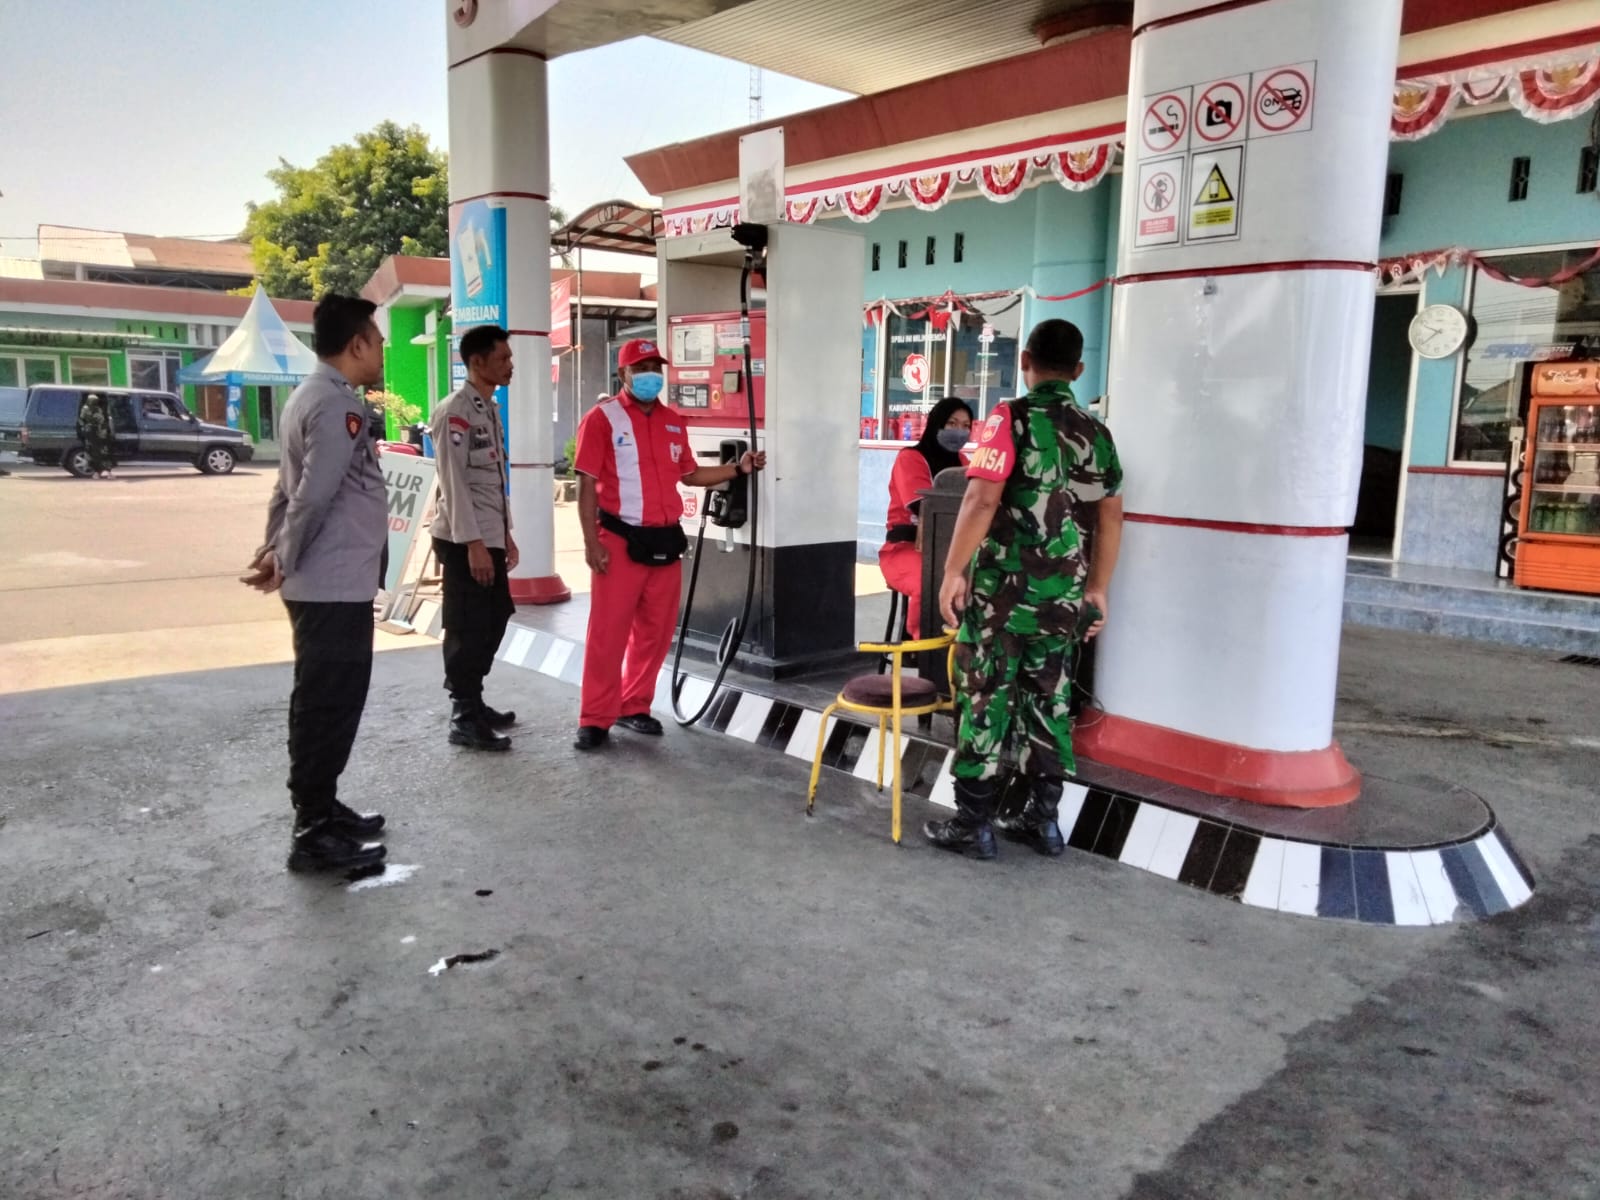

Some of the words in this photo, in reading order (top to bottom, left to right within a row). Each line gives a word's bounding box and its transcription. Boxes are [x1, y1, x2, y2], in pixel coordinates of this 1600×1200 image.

[453, 304, 500, 322] EMBELIAN
[384, 470, 424, 492] LUR
[386, 490, 417, 518] M
